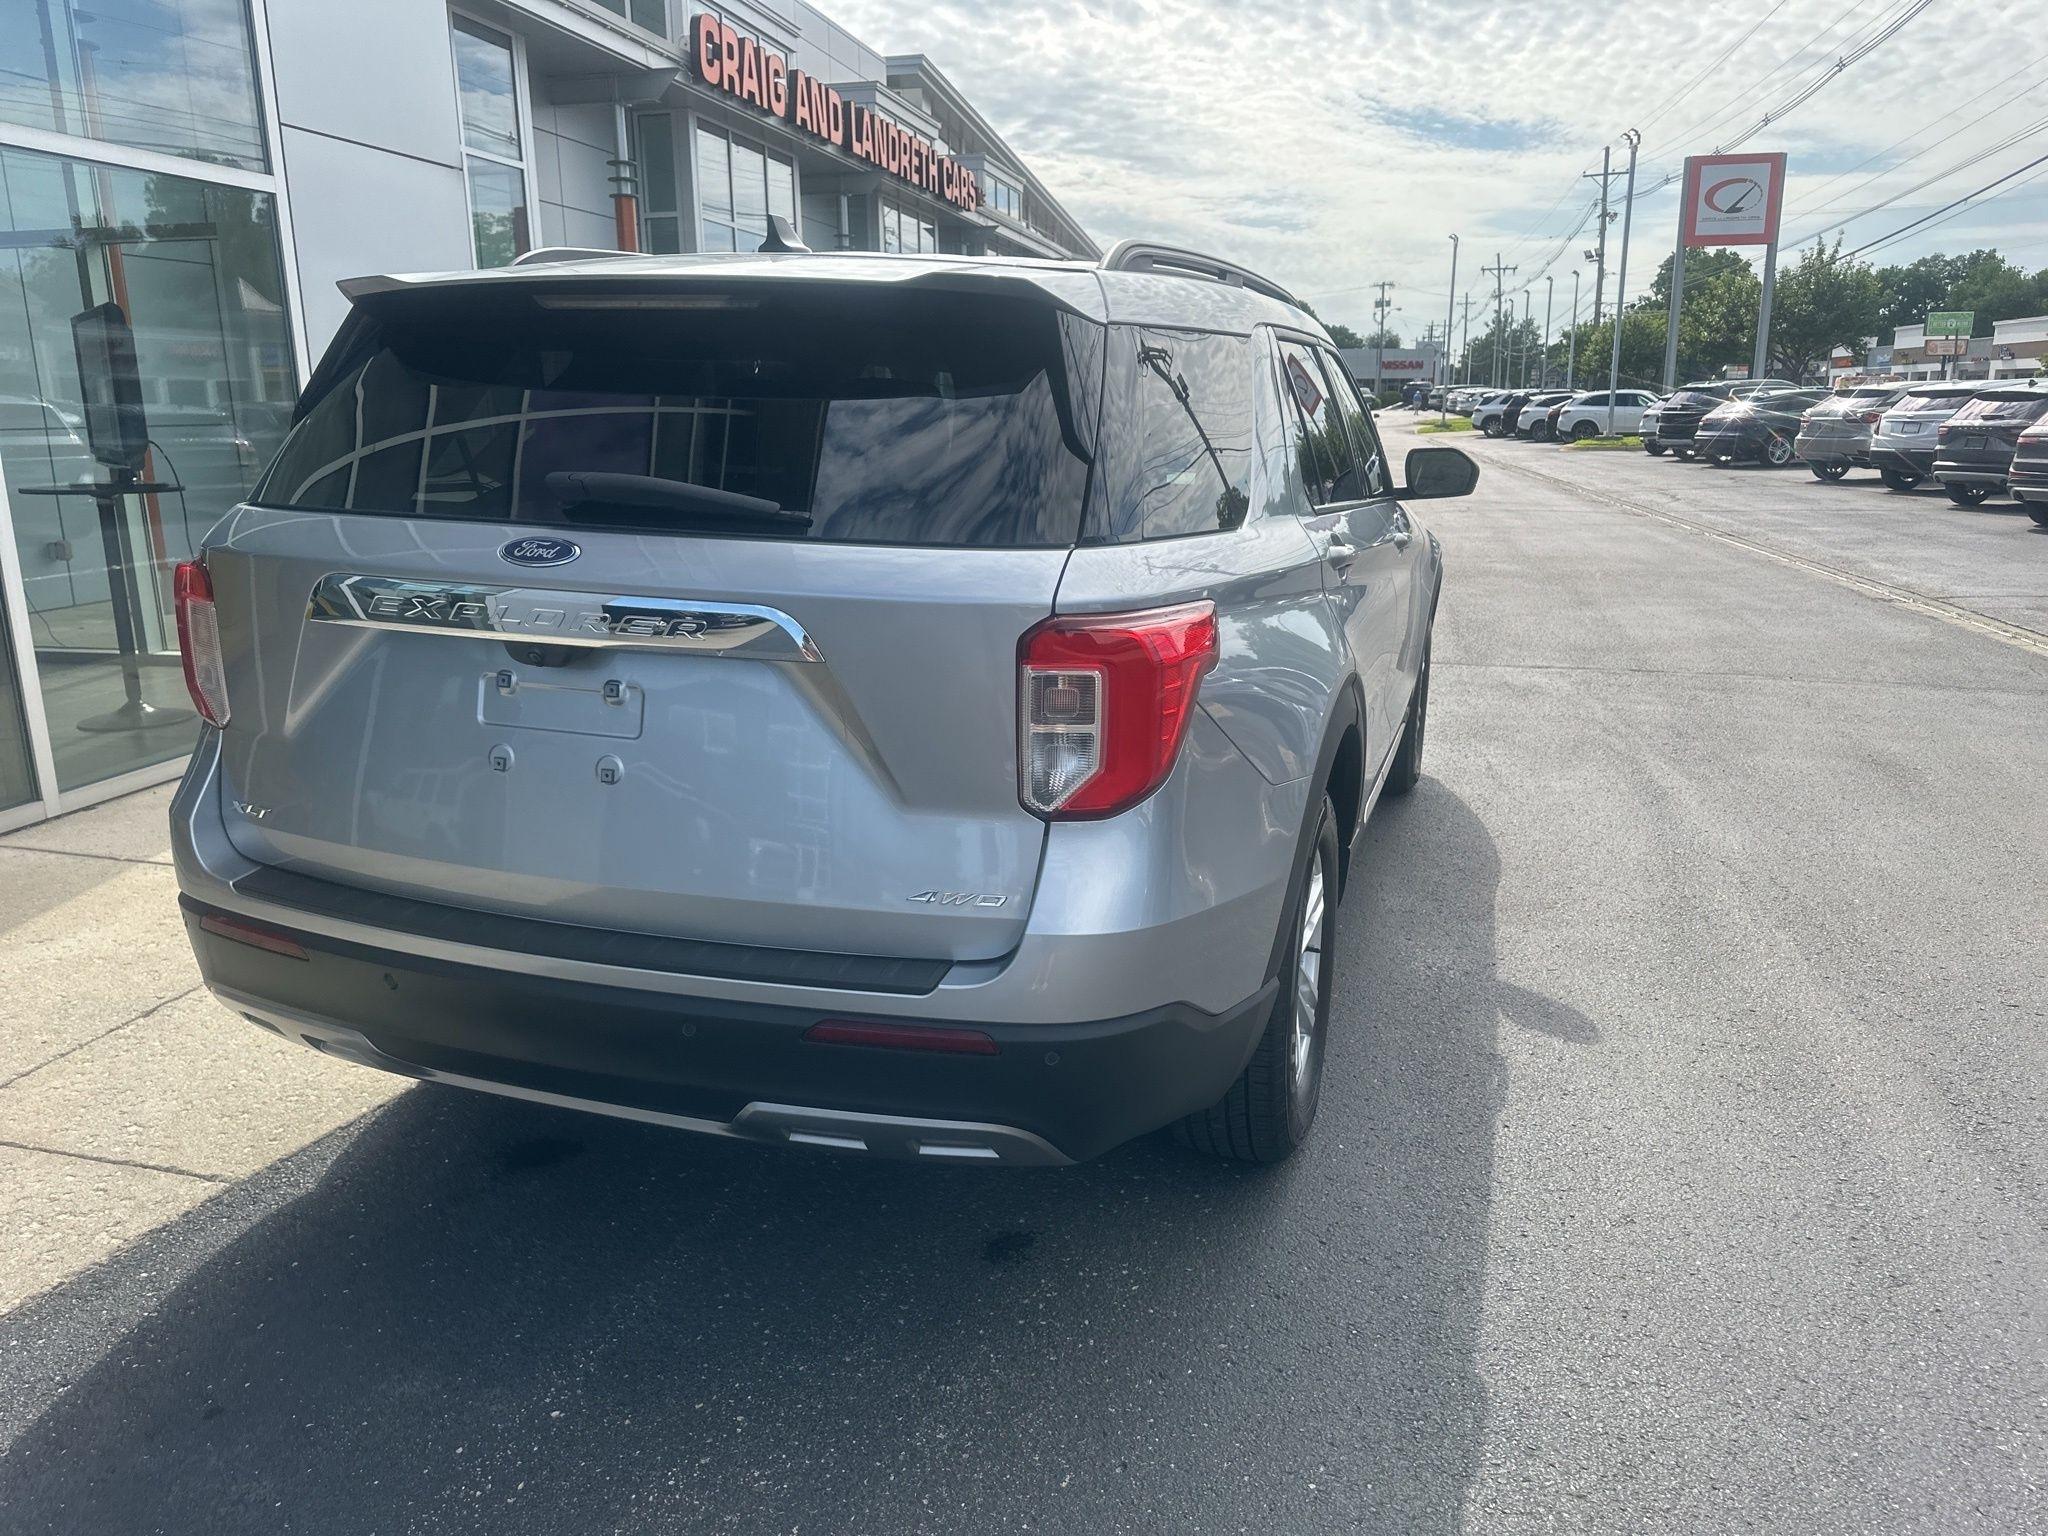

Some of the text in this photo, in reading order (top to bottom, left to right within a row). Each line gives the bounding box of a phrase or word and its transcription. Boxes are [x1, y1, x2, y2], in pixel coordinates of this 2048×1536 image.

[698, 13, 977, 212] CRAIG AND LANDRETH CARS
[1381, 360, 1424, 370] NISSAN
[514, 540, 561, 559] Ford
[368, 594, 707, 642] EXPLORER
[232, 800, 273, 819] XLT
[906, 890, 1008, 907] 4WD
